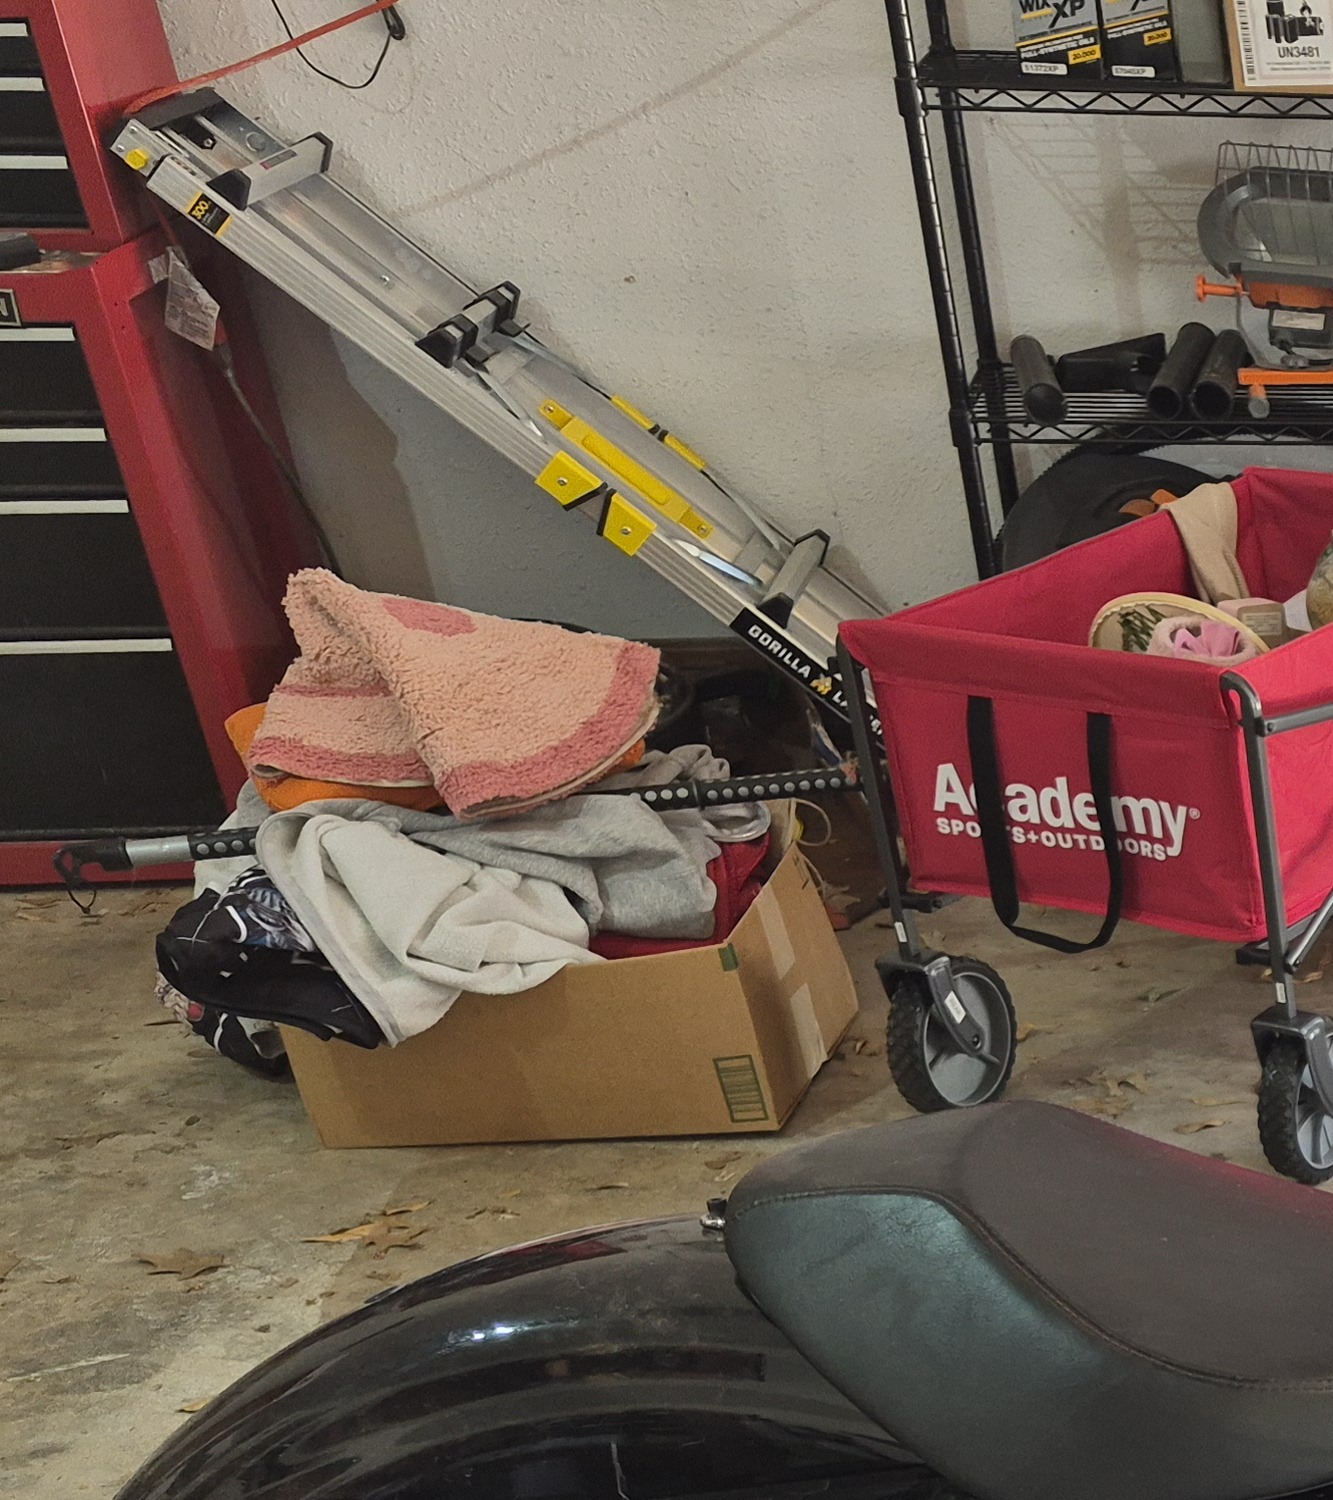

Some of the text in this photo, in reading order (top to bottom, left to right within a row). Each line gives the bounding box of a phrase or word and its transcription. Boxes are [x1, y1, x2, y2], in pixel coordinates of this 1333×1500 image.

[1277, 46, 1320, 58] UN3481
[191, 200, 210, 220] 300
[747, 624, 811, 679] GORILLA
[933, 762, 1188, 857] Aademy
[936, 817, 1167, 861] SPOS+OUTDORS
